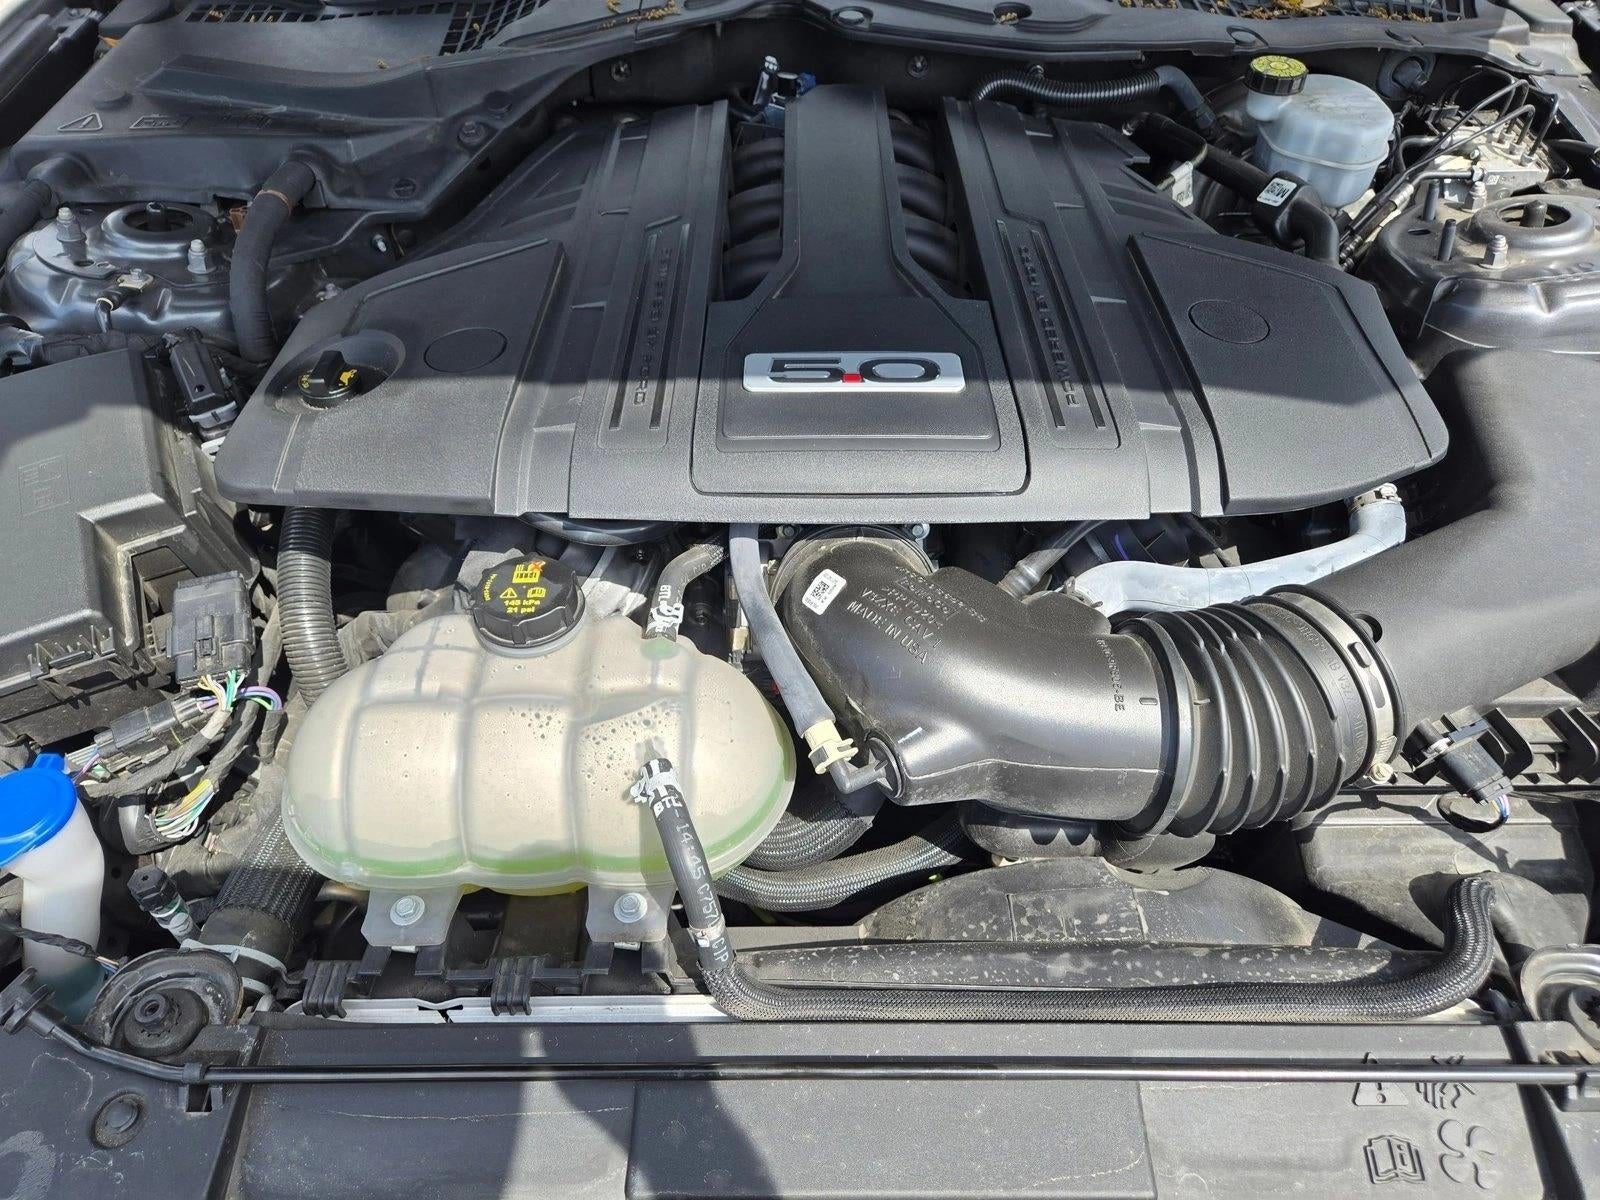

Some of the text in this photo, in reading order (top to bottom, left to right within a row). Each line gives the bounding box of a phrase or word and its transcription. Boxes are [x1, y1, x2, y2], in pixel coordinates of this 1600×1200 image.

[769, 358, 941, 383] 5.0
[847, 601, 928, 664] MADE IN USA
[904, 616, 933, 640] CAV
[712, 937, 729, 962] C1P
